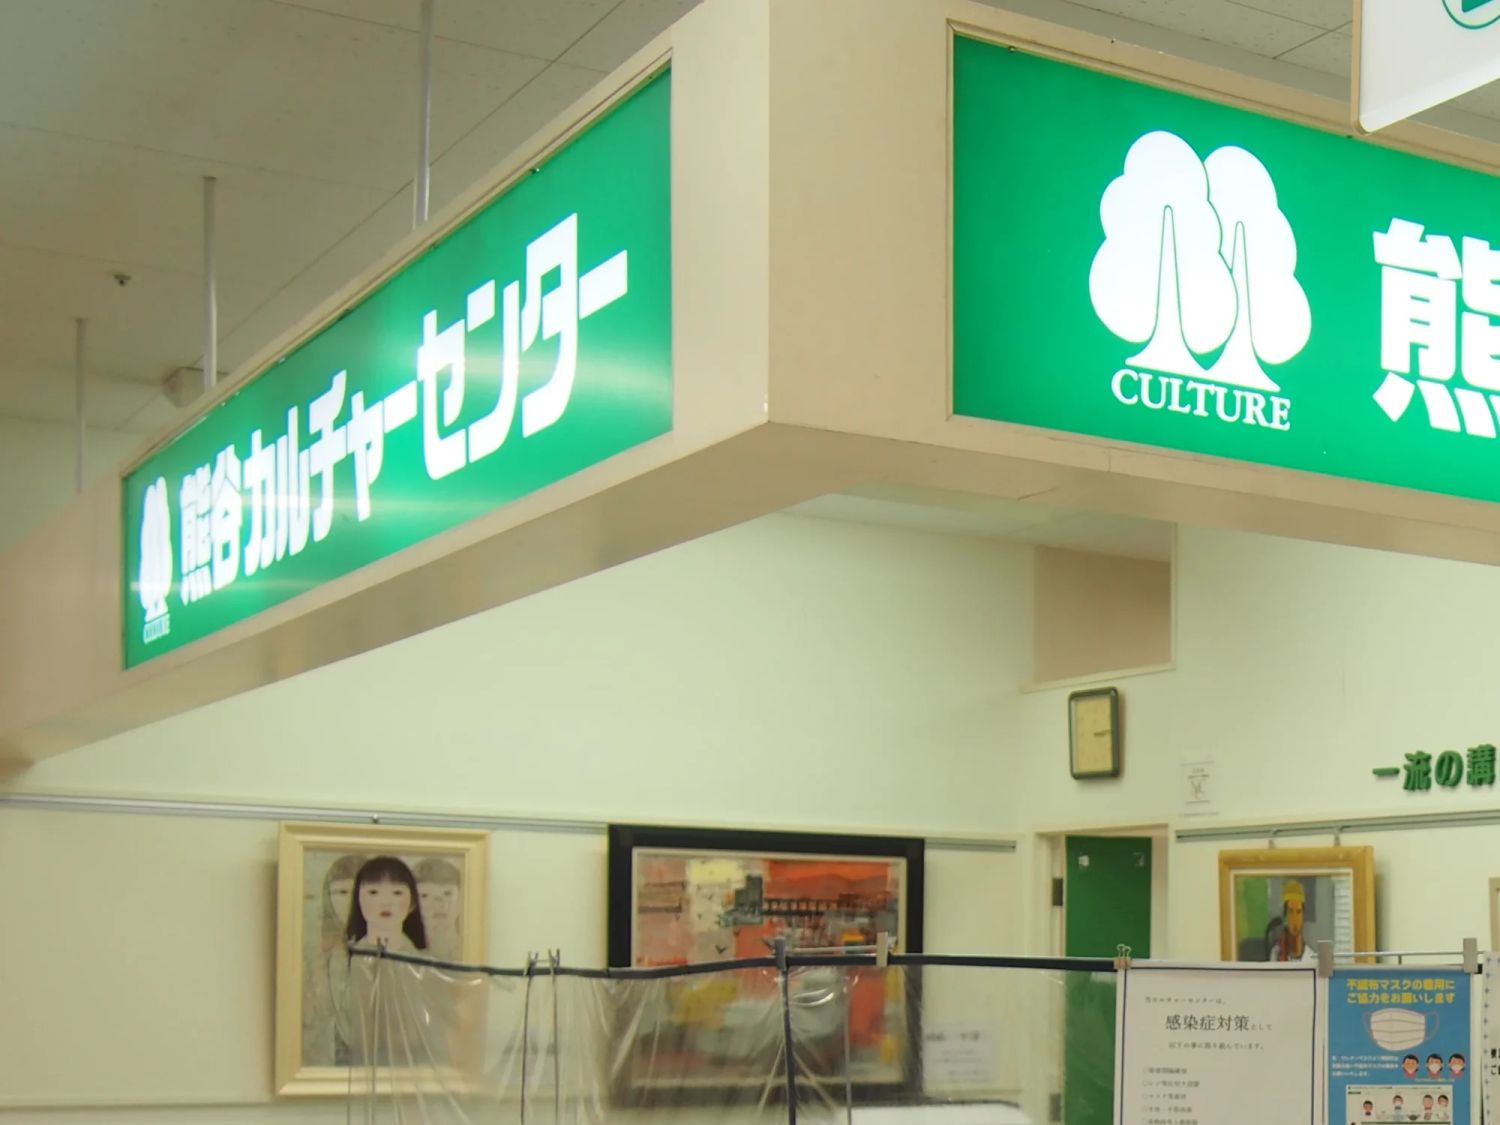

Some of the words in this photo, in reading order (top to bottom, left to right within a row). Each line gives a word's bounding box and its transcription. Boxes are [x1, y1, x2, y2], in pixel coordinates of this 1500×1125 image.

[180, 213, 627, 606] 熊谷カルチャーセンター
[1111, 369, 1291, 431] CULTURE
